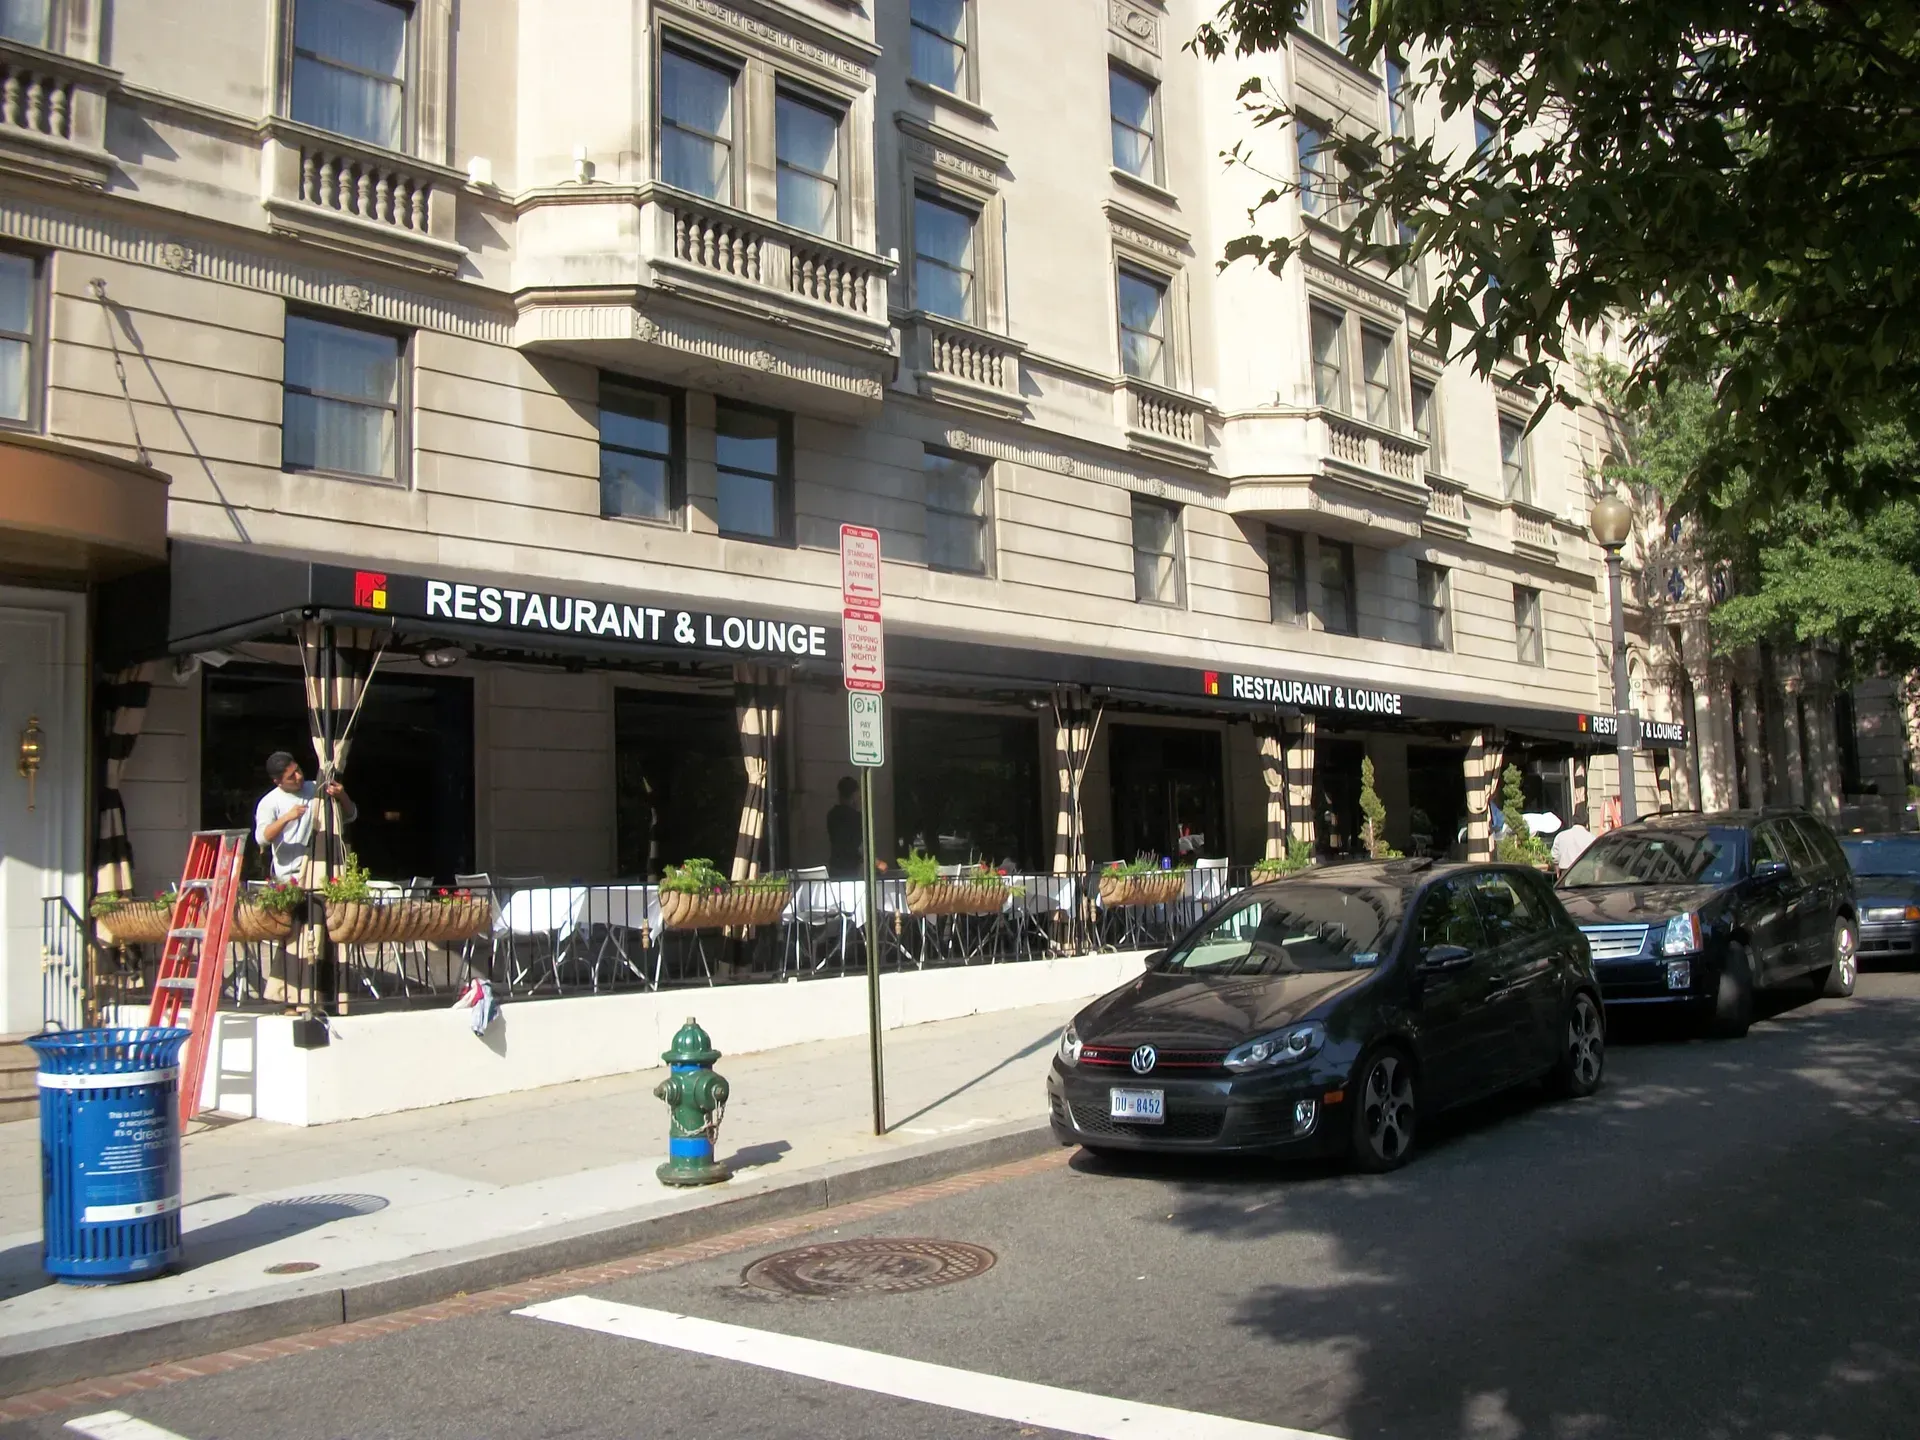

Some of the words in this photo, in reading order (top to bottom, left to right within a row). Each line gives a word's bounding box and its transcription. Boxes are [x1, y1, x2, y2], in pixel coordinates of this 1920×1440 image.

[425, 580, 666, 641] RESTAURANT
[673, 611, 696, 645] &
[705, 614, 827, 656] LOUNGE
[857, 624, 868, 632] NO
[848, 634, 879, 645] STOPPING
[851, 652, 877, 662] NIGHTLY
[1232, 674, 1332, 707] RESTAURANT
[1335, 690, 1345, 708] &
[1348, 689, 1402, 715] LOUNGE
[1592, 716, 1644, 737] RESTAT
[1646, 725, 1652, 738] &
[1653, 723, 1683, 740] LOUNGE
[862, 731, 871, 739] TO
[857, 740, 875, 748] PARK
[1115, 1097, 1127, 1112] DU
[1136, 1098, 1160, 1114] 8452
